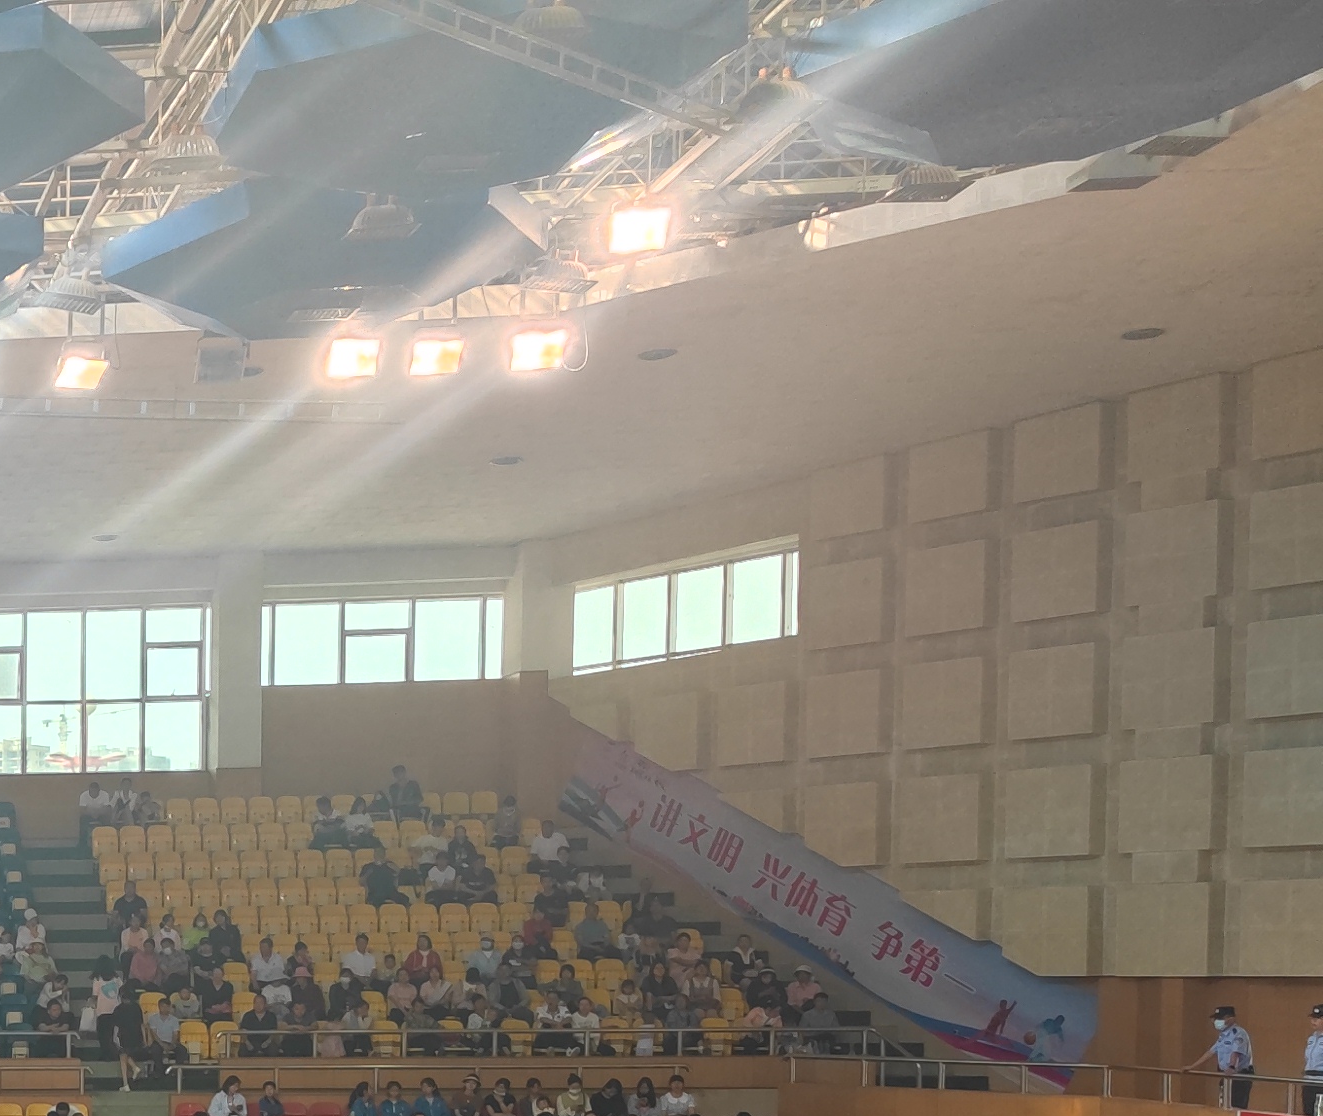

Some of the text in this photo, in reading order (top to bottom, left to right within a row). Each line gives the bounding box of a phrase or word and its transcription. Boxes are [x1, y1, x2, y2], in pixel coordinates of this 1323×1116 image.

[649, 793, 977, 994] 讲文明 兴体育 争第一
